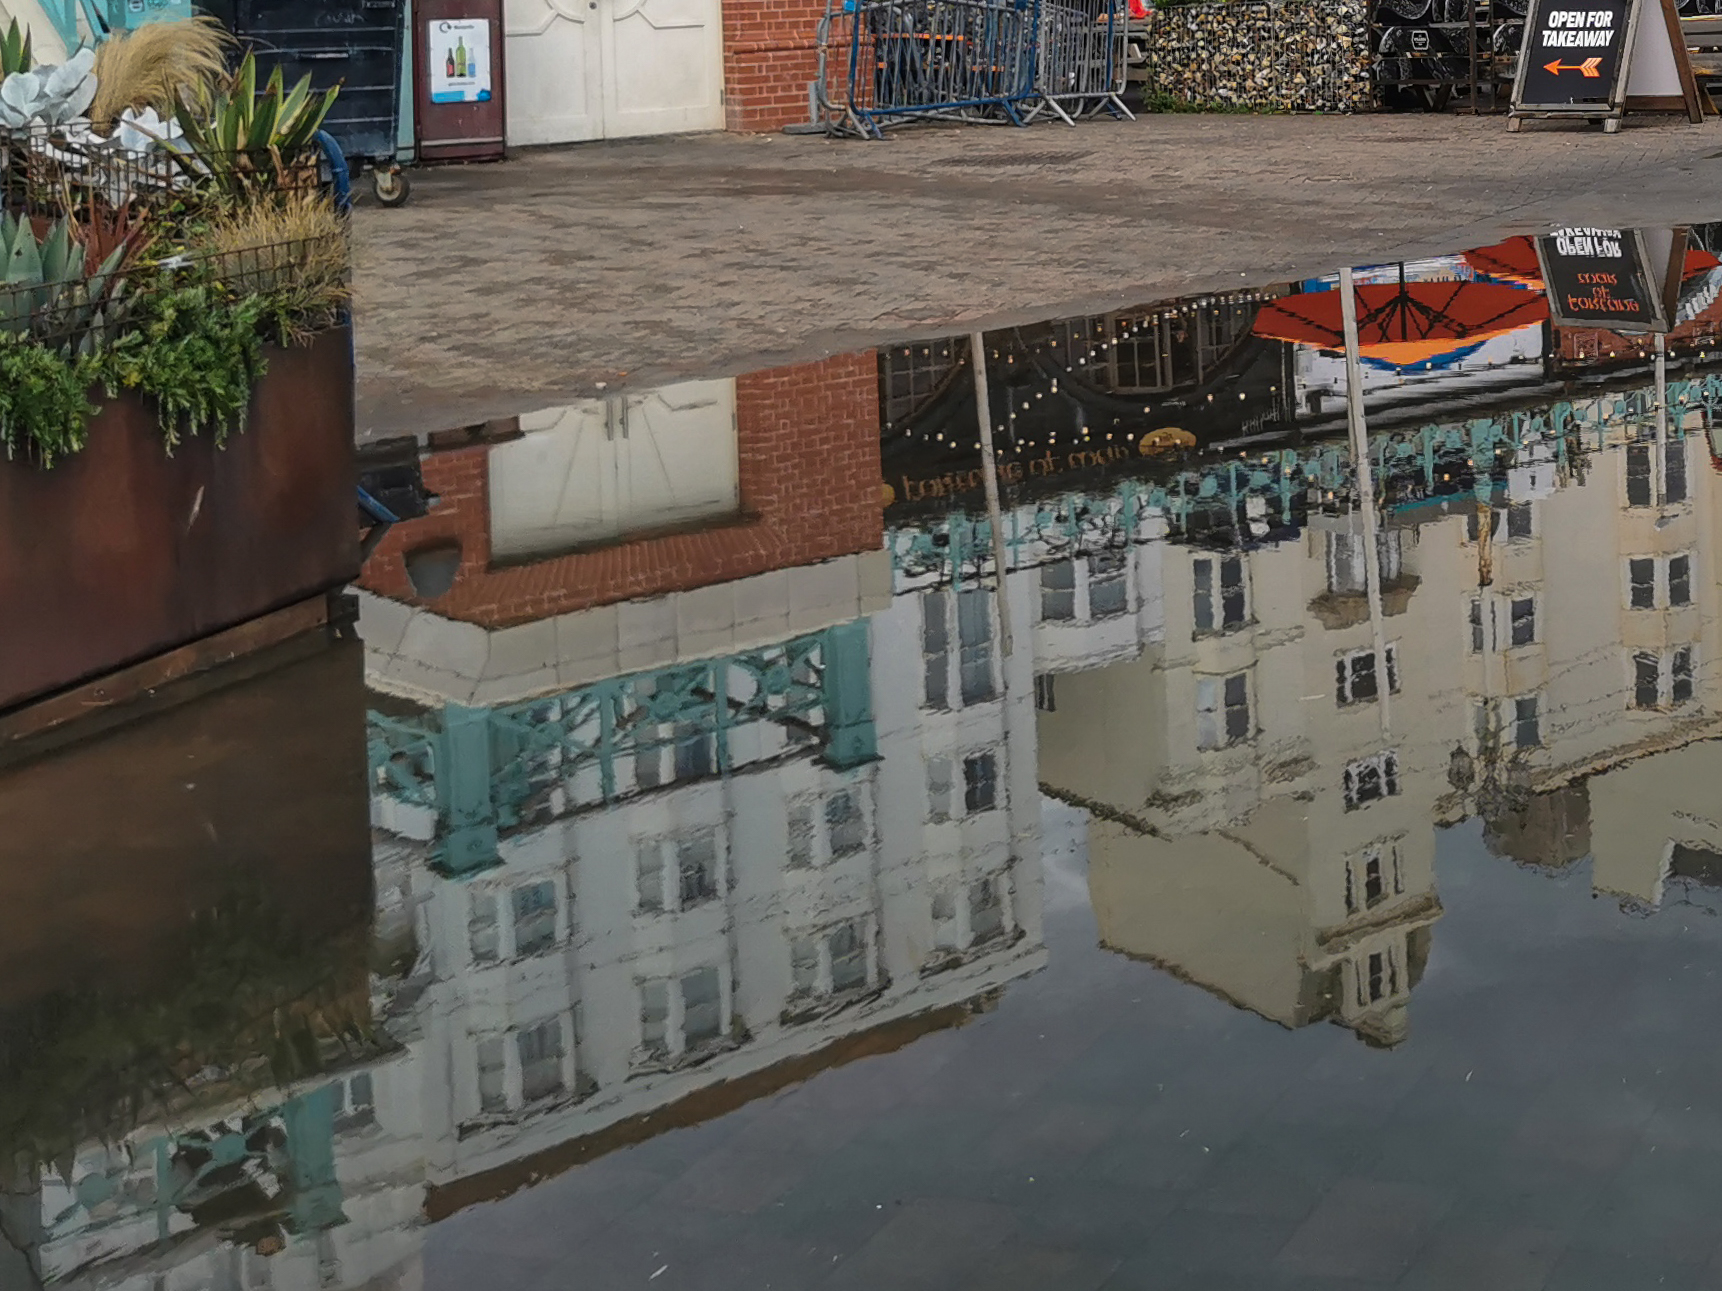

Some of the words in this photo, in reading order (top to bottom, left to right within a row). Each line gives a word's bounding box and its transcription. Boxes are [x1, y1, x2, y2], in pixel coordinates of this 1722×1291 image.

[1548, 11, 1586, 28] OPEN
[1586, 10, 1613, 27] FOR
[1542, 30, 1614, 47] TAKEAWAY
